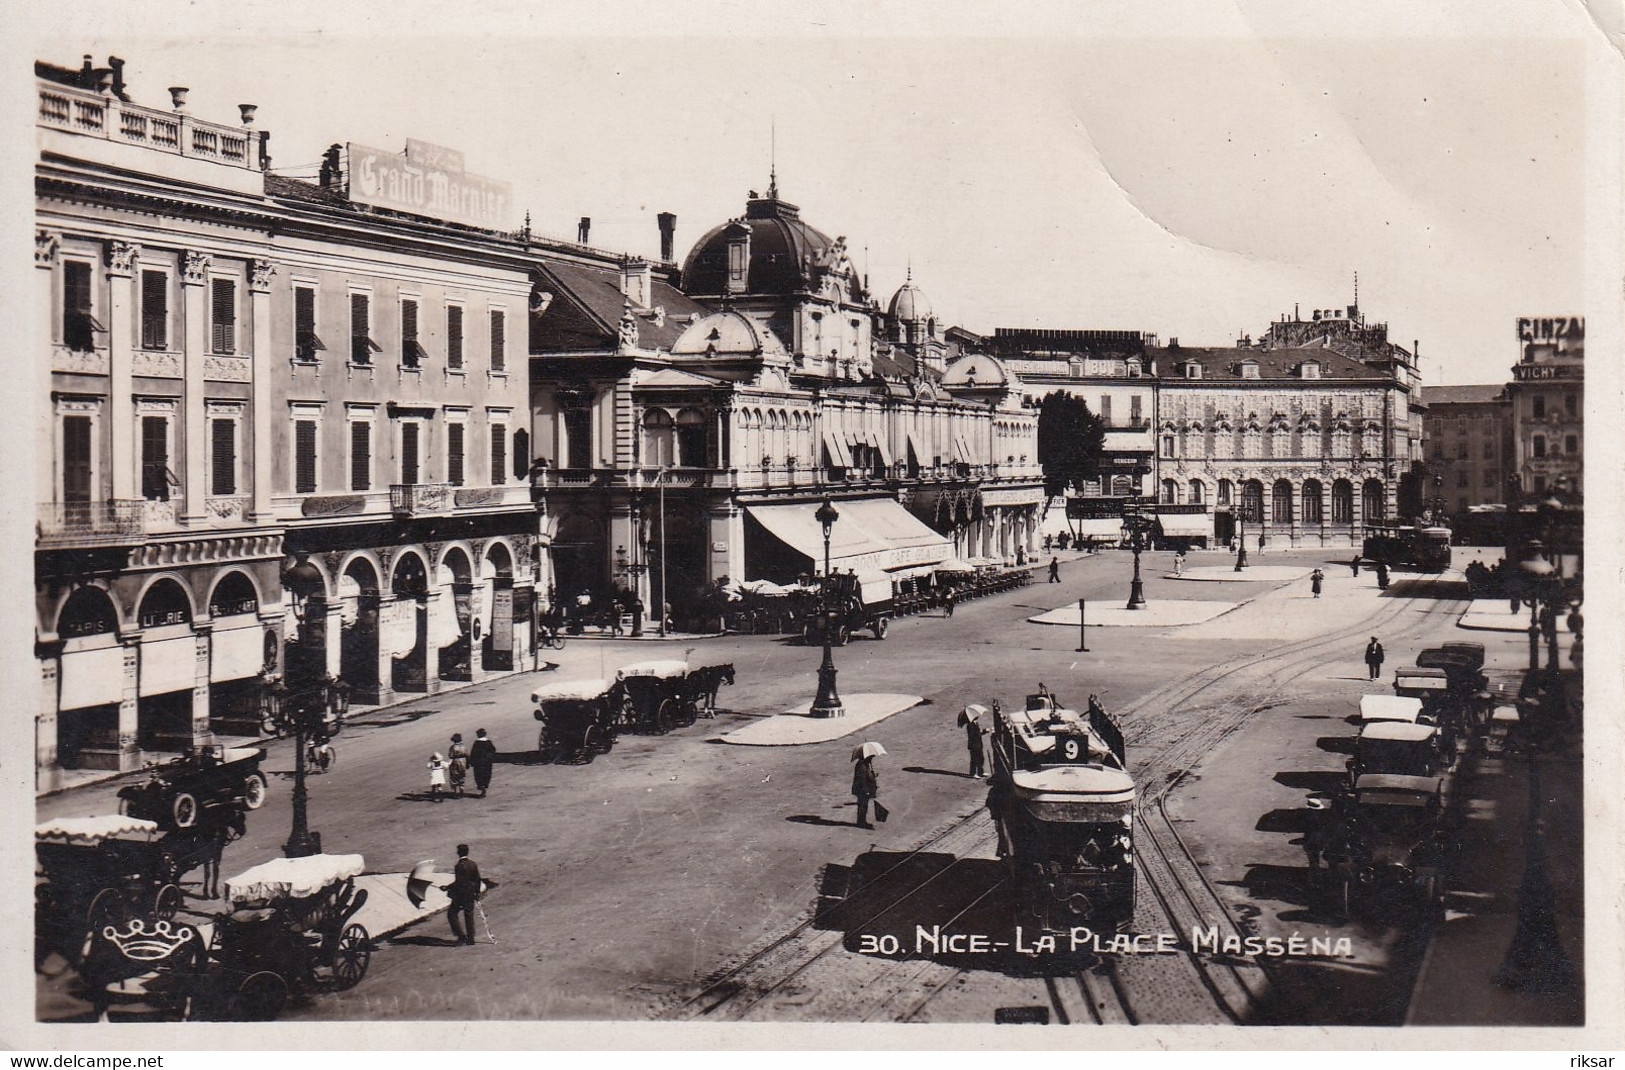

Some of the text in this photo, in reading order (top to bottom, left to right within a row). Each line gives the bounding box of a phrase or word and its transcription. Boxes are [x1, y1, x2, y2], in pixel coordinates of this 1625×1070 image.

[359, 155, 425, 207] Grand
[426, 170, 506, 222] Marnier
[1519, 366, 1556, 379] VICHY
[1065, 739, 1079, 760] 9
